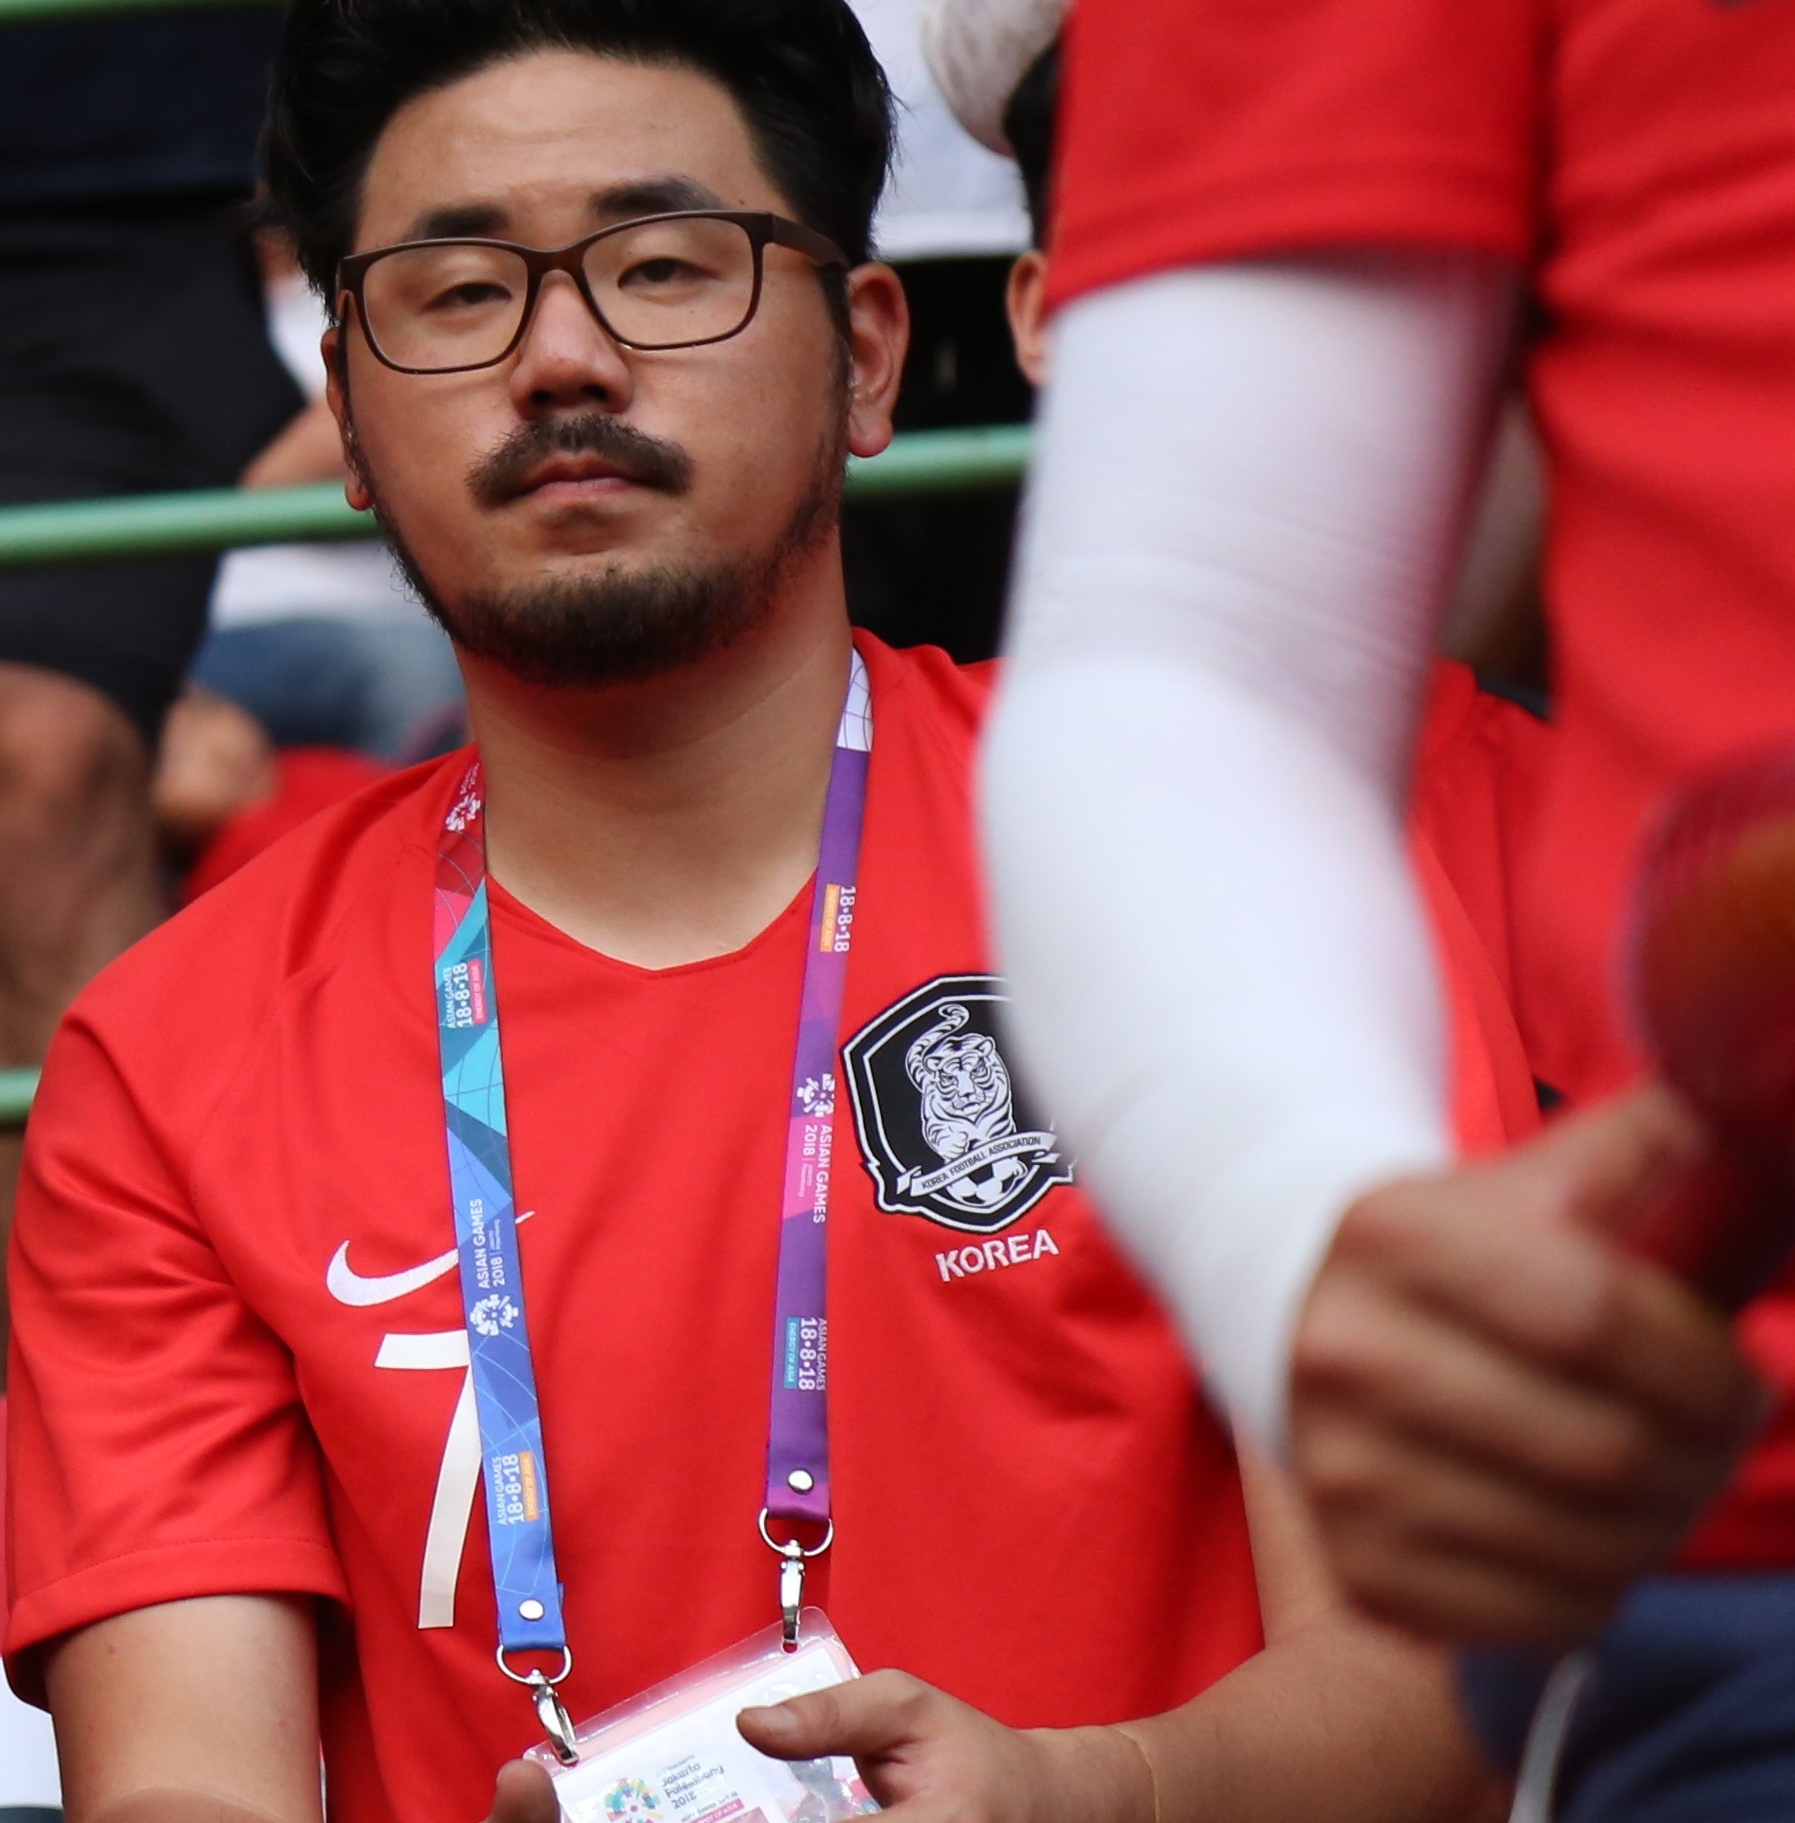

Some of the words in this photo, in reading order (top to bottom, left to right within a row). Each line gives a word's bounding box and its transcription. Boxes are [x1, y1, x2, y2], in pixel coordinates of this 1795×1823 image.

[802, 1124, 817, 1156] 2018
[817, 1124, 832, 1168] ASIAN
[921, 1172, 949, 1190] KOREA
[949, 1152, 986, 1176] FOOTBALL
[988, 1136, 1041, 1156] ASSOCIATION
[813, 1171, 828, 1224] GAMES
[470, 1198, 485, 1246] GAMES
[474, 1248, 490, 1289] ASIAN
[490, 1256, 506, 1287] 2018
[935, 1229, 1059, 1282] KOREA
[817, 1317, 828, 1351] ASIAN
[816, 1353, 826, 1391] GAMES
[375, 1329, 482, 1628] 7
[491, 1456, 504, 1492] GAMES
[496, 1493, 508, 1526] ASIAN
